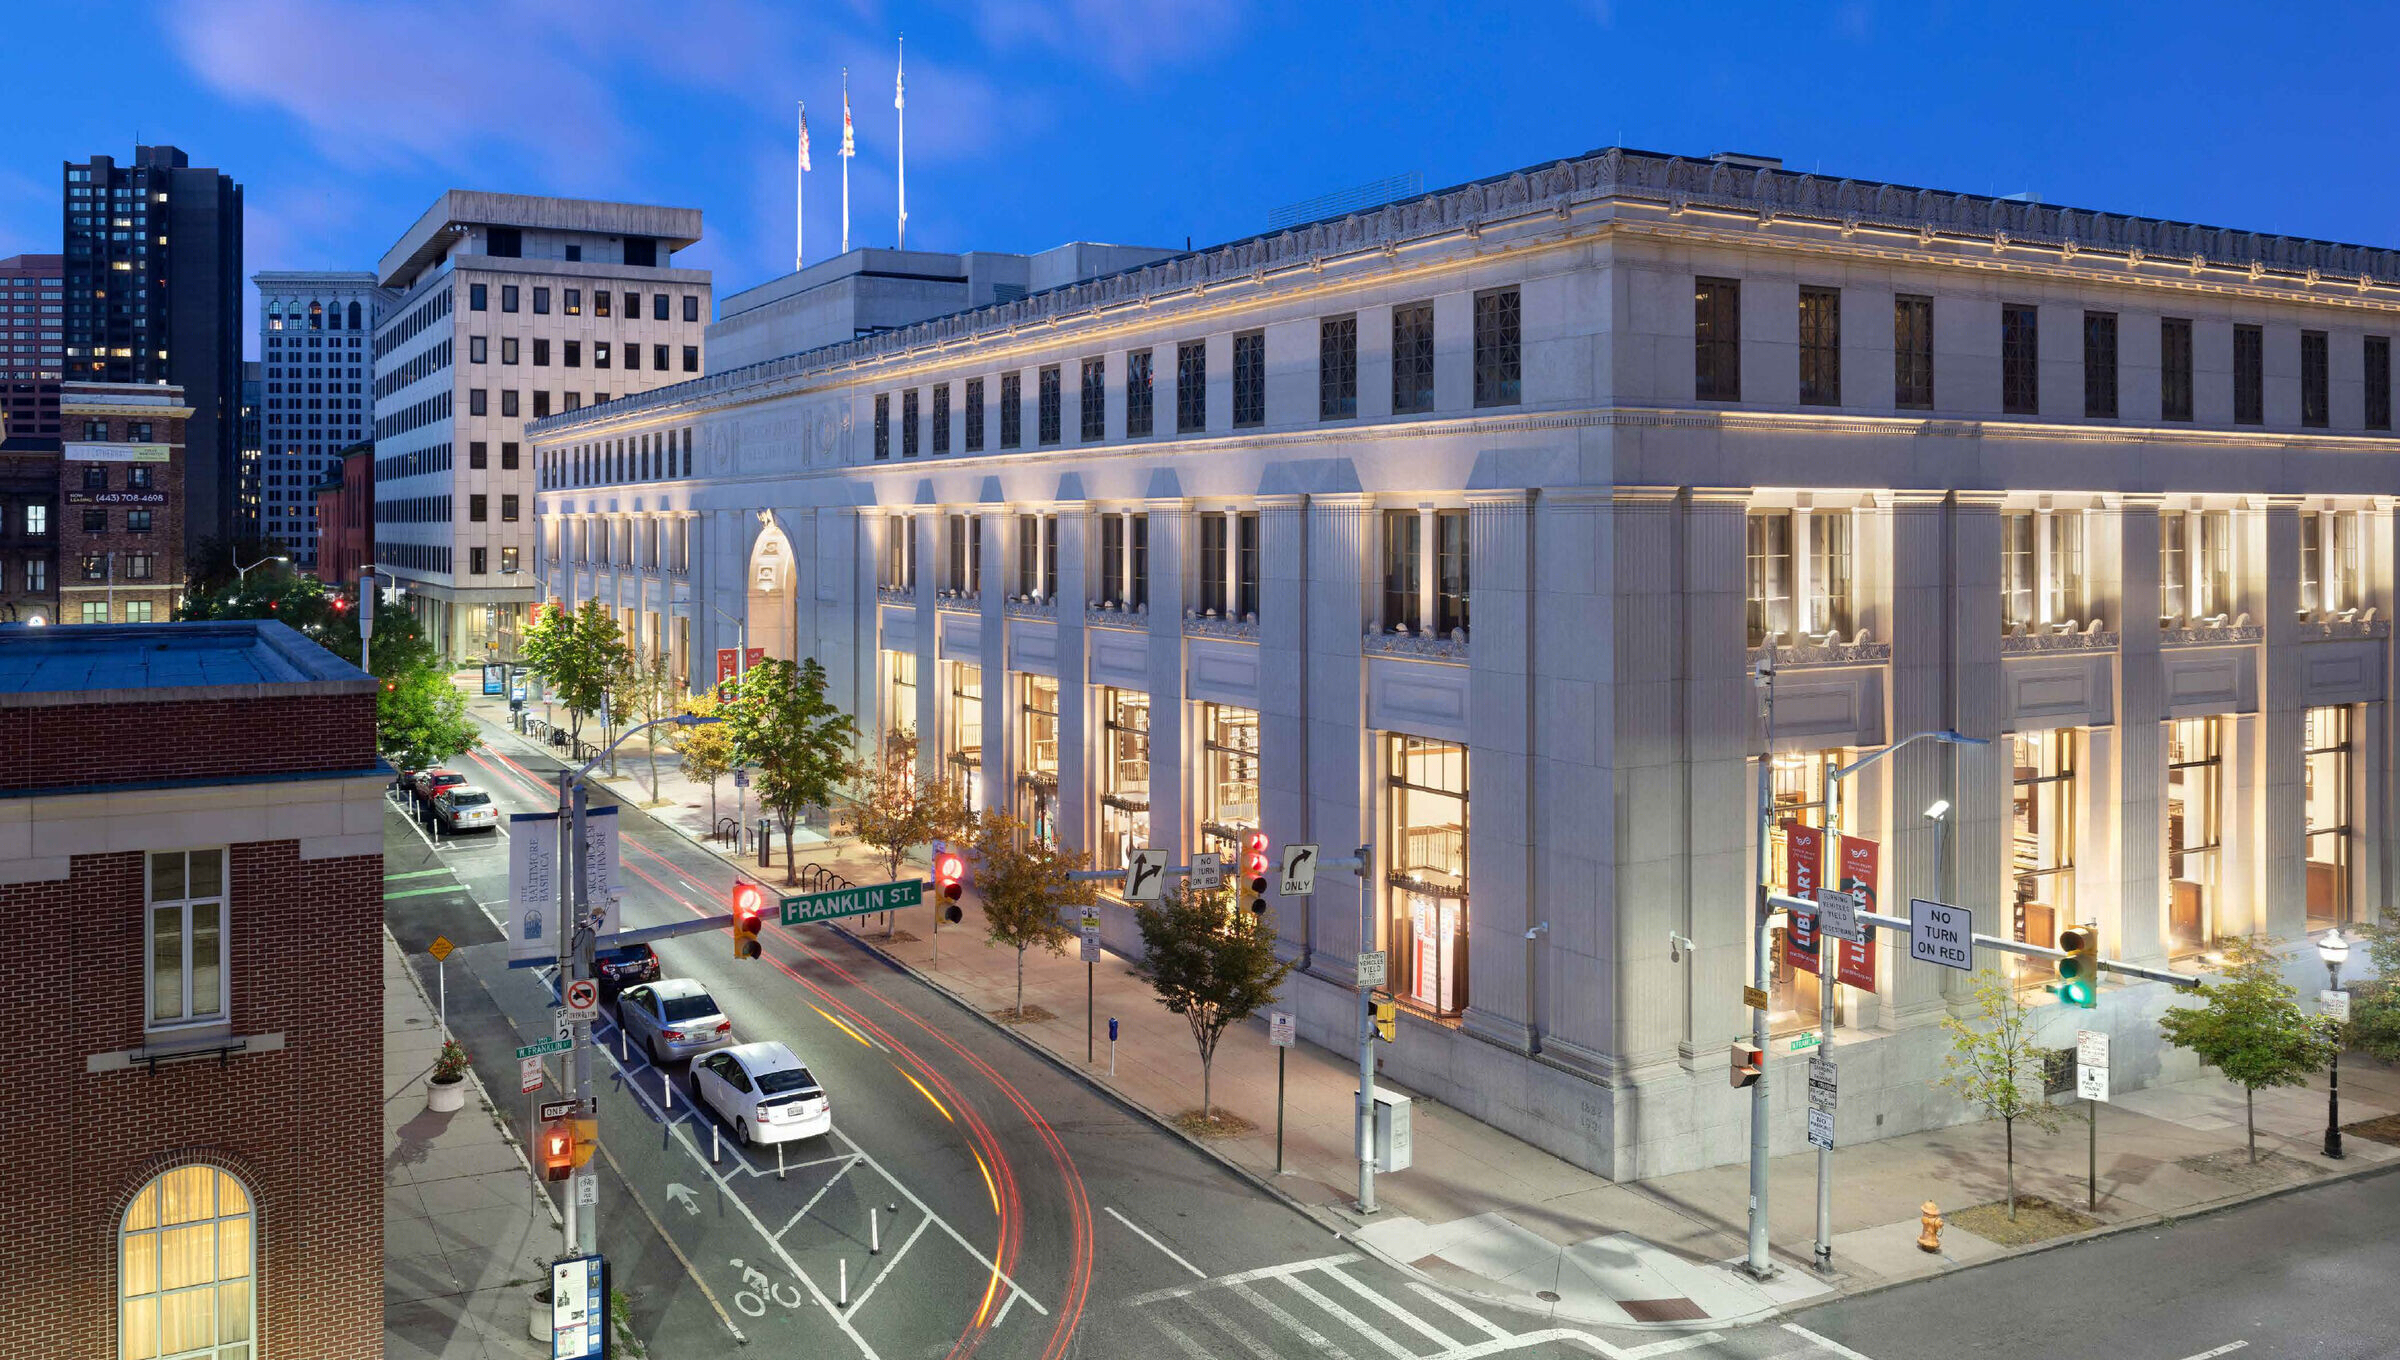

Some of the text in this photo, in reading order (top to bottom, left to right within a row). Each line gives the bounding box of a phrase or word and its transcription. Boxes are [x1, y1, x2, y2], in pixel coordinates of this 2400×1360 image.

[95, 494, 164, 503] (443) 708-4698
[1201, 857, 1211, 865] NO
[529, 839, 539, 903] BALTIMORE
[540, 852, 549, 902] BASILICA
[1198, 868, 1215, 876] TURN
[1285, 881, 1310, 891] ONLY
[787, 887, 915, 920] FRANKLIN ST.
[1797, 861, 1811, 947] LIBARY
[1823, 893, 1848, 903] TURNING
[1827, 911, 1847, 921] YIELD
[1931, 910, 1951, 924] NO
[1925, 925, 1958, 943] TURN
[1918, 941, 1965, 962] ON RED
[1363, 965, 1381, 974] YIELD
[528, 1042, 563, 1056] FRANKLIN
[546, 1107, 563, 1116] ONE
